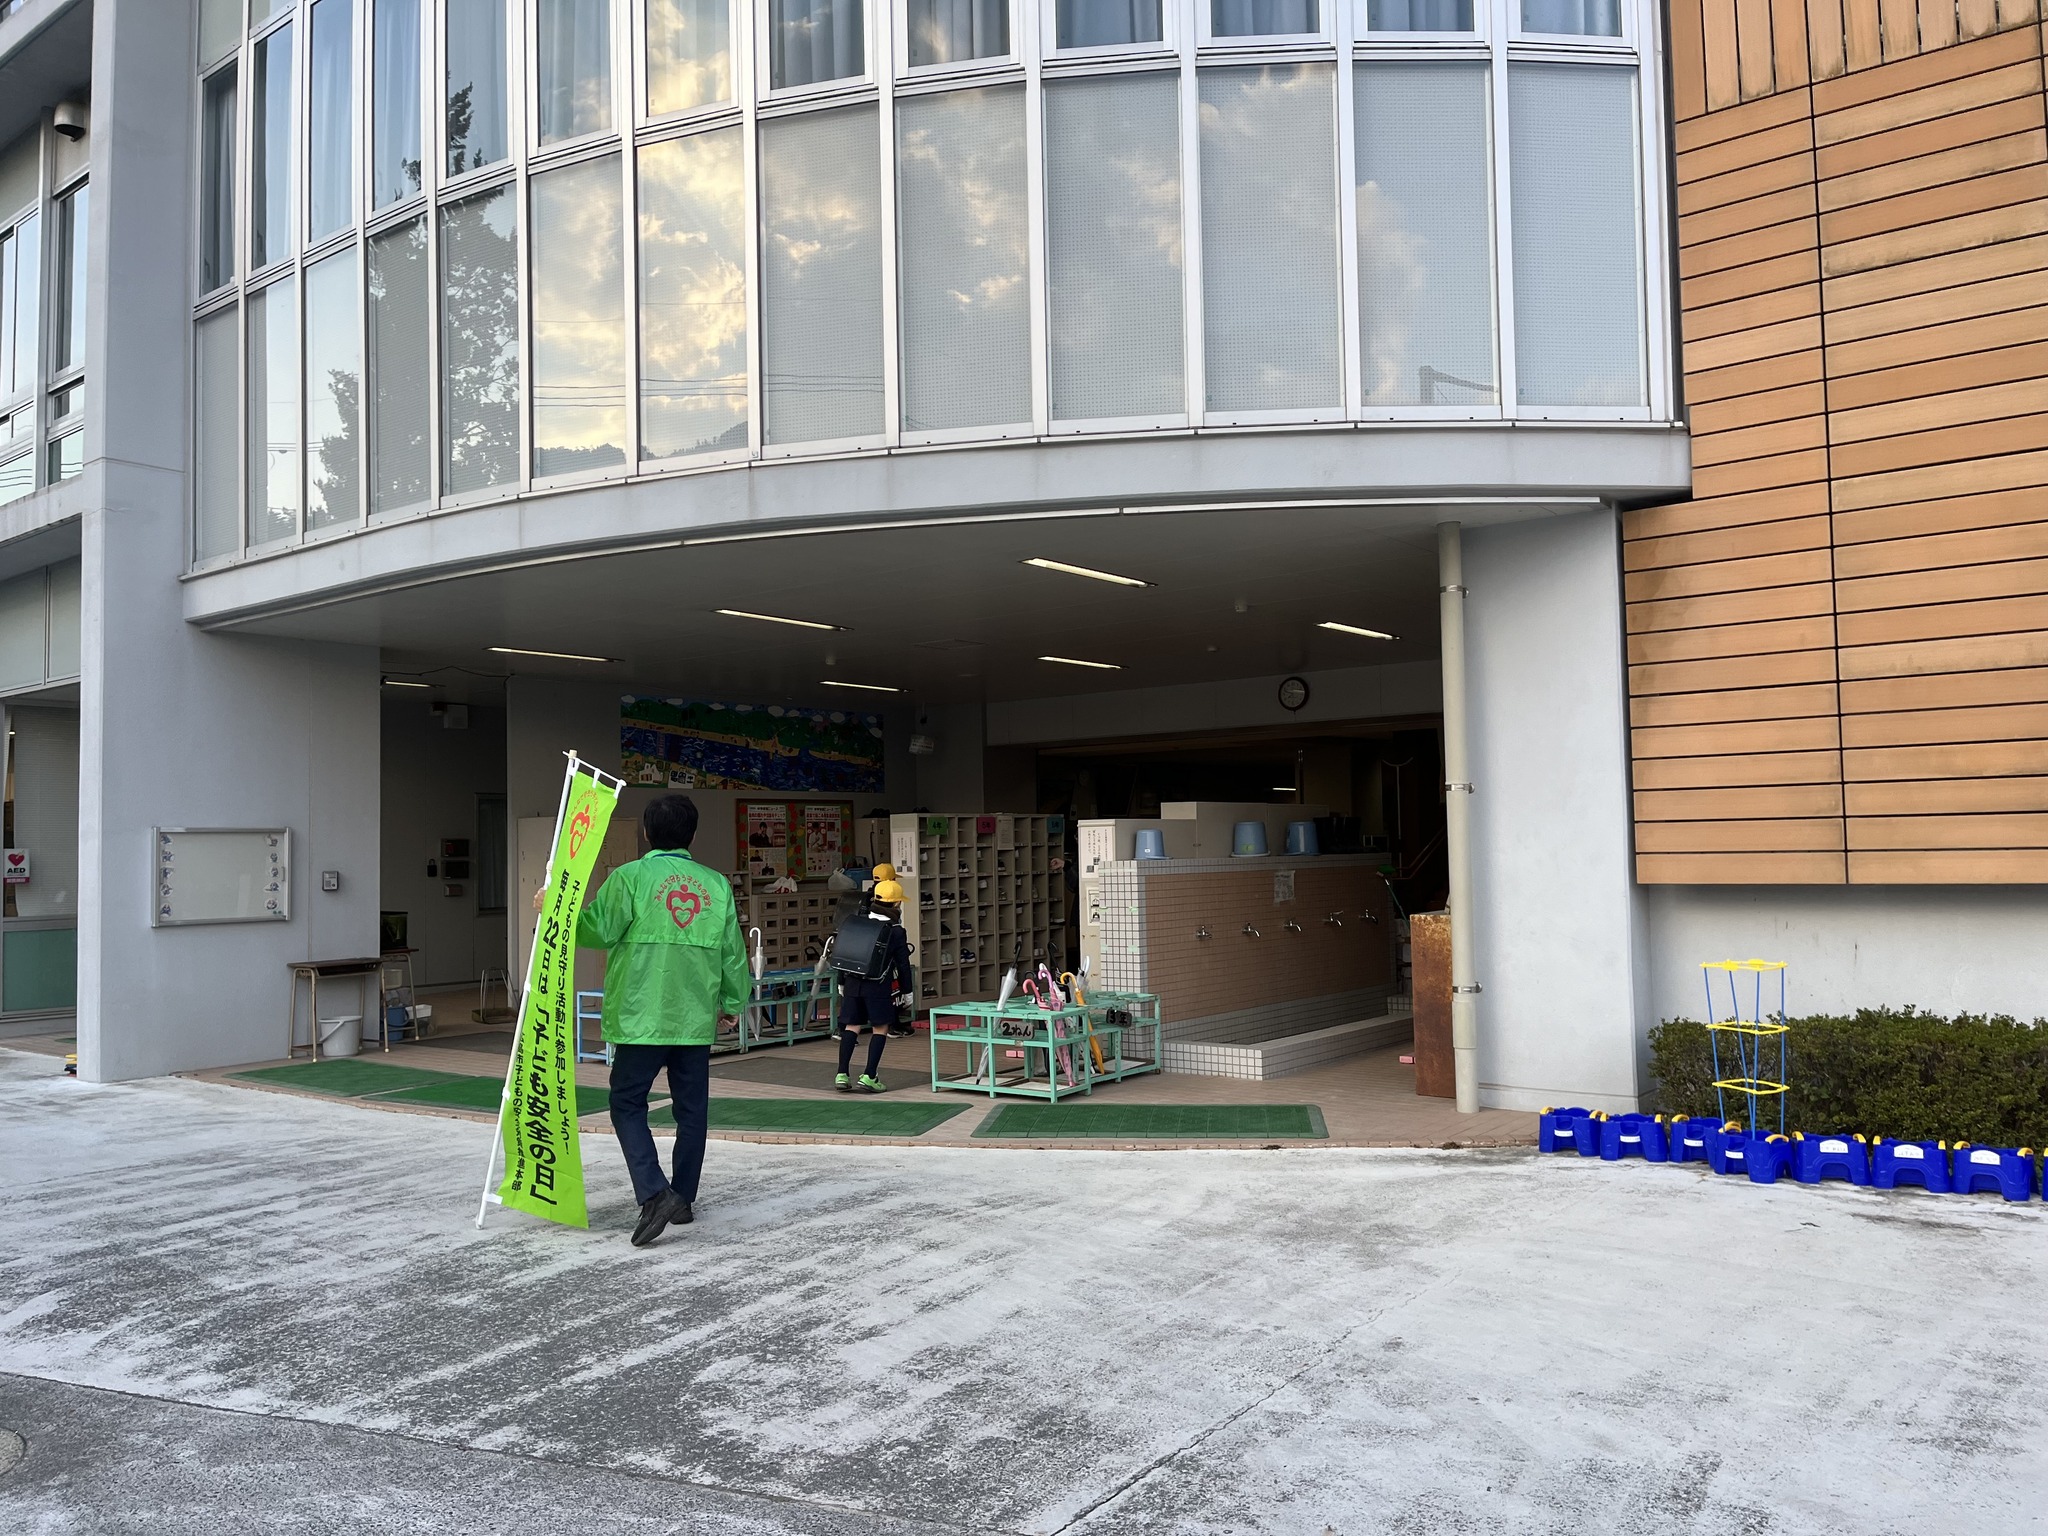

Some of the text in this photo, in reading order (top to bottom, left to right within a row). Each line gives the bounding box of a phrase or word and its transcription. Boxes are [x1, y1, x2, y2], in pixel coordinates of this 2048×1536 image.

[555, 880, 581, 1155] 子どもの見守り活動に参加しましょう！
[1002, 1021, 1032, 1037] 2ねん
